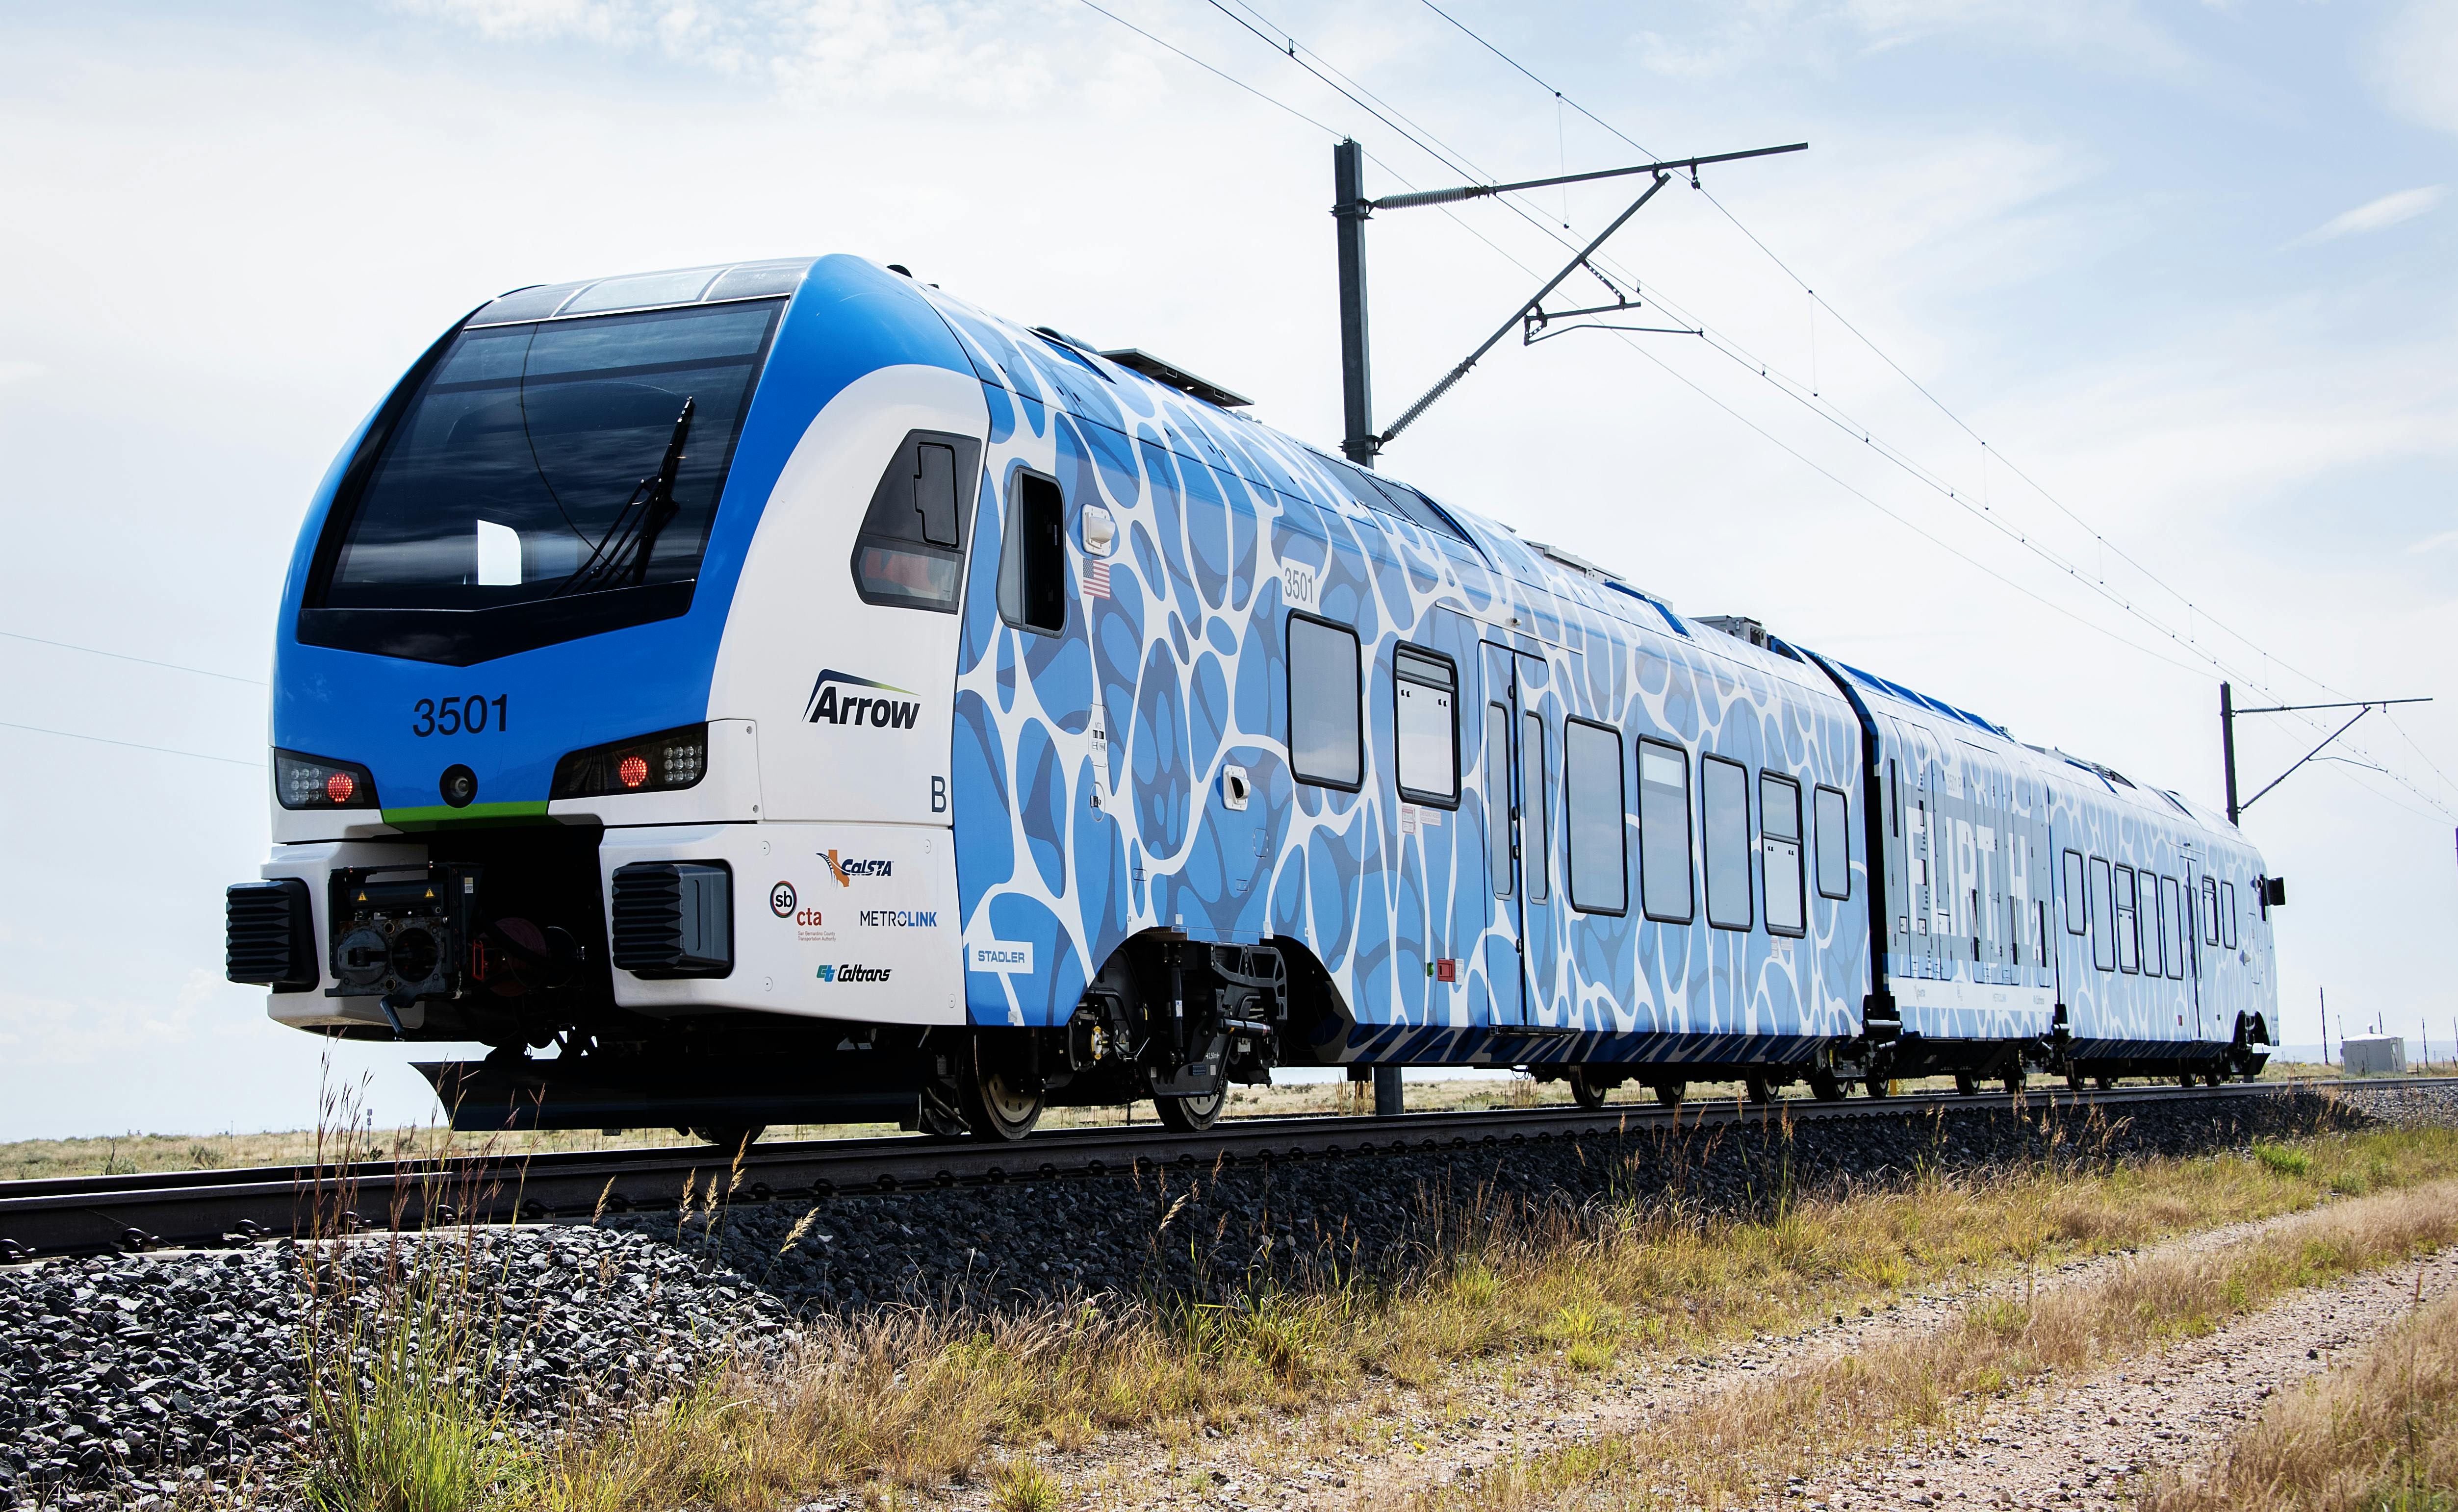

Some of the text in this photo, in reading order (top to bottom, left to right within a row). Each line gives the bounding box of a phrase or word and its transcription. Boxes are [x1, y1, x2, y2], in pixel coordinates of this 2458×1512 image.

[1285, 567, 1313, 604] 3501
[412, 693, 507, 737] 3501
[809, 686, 921, 730] Arrow
[931, 775, 947, 813] B
[841, 858, 892, 877] CalSTA
[1906, 806, 1995, 941] FLIRT
[775, 890, 793, 908] sb
[796, 907, 822, 926] cta
[860, 910, 938, 927] METROLINK
[978, 950, 1025, 963] STADLER
[837, 964, 891, 982] Caltrans
